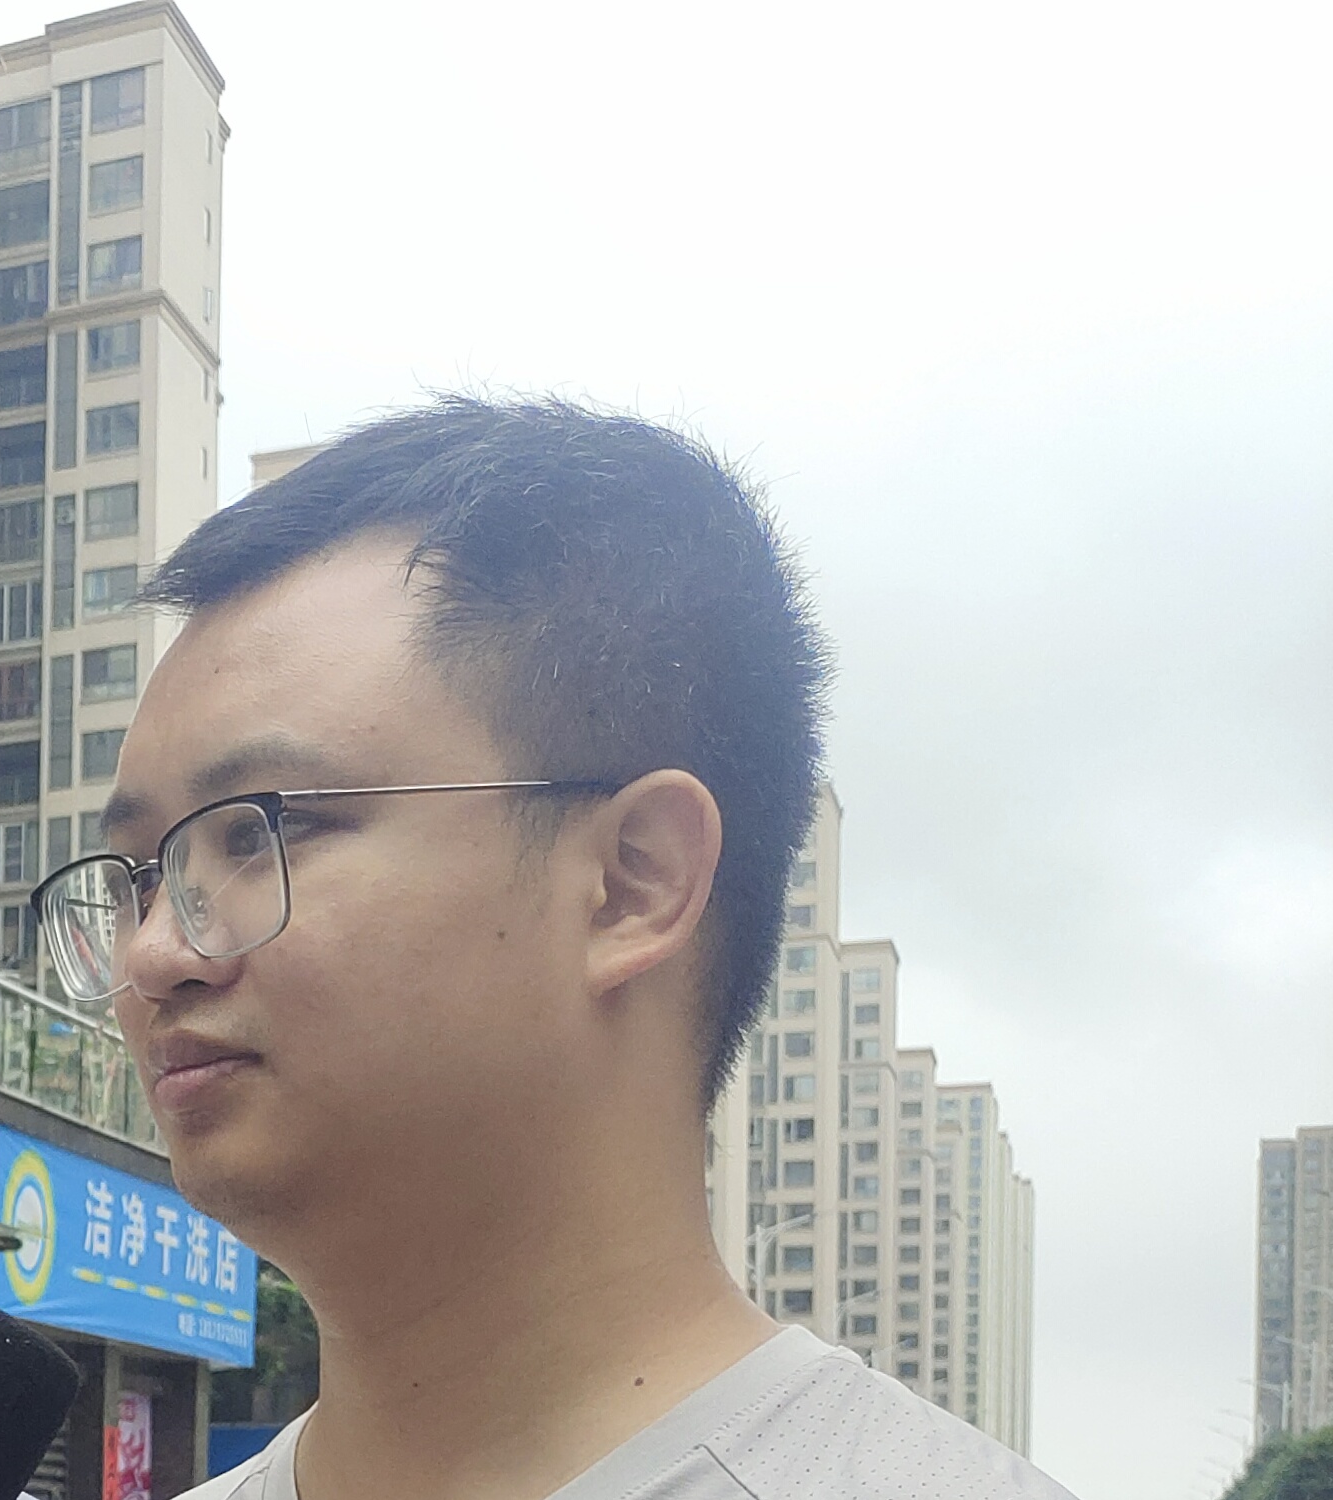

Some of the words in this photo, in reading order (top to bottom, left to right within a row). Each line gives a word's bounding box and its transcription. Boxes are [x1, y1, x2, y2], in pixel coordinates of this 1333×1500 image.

[85, 1178, 239, 1295] 洁净干洗店
